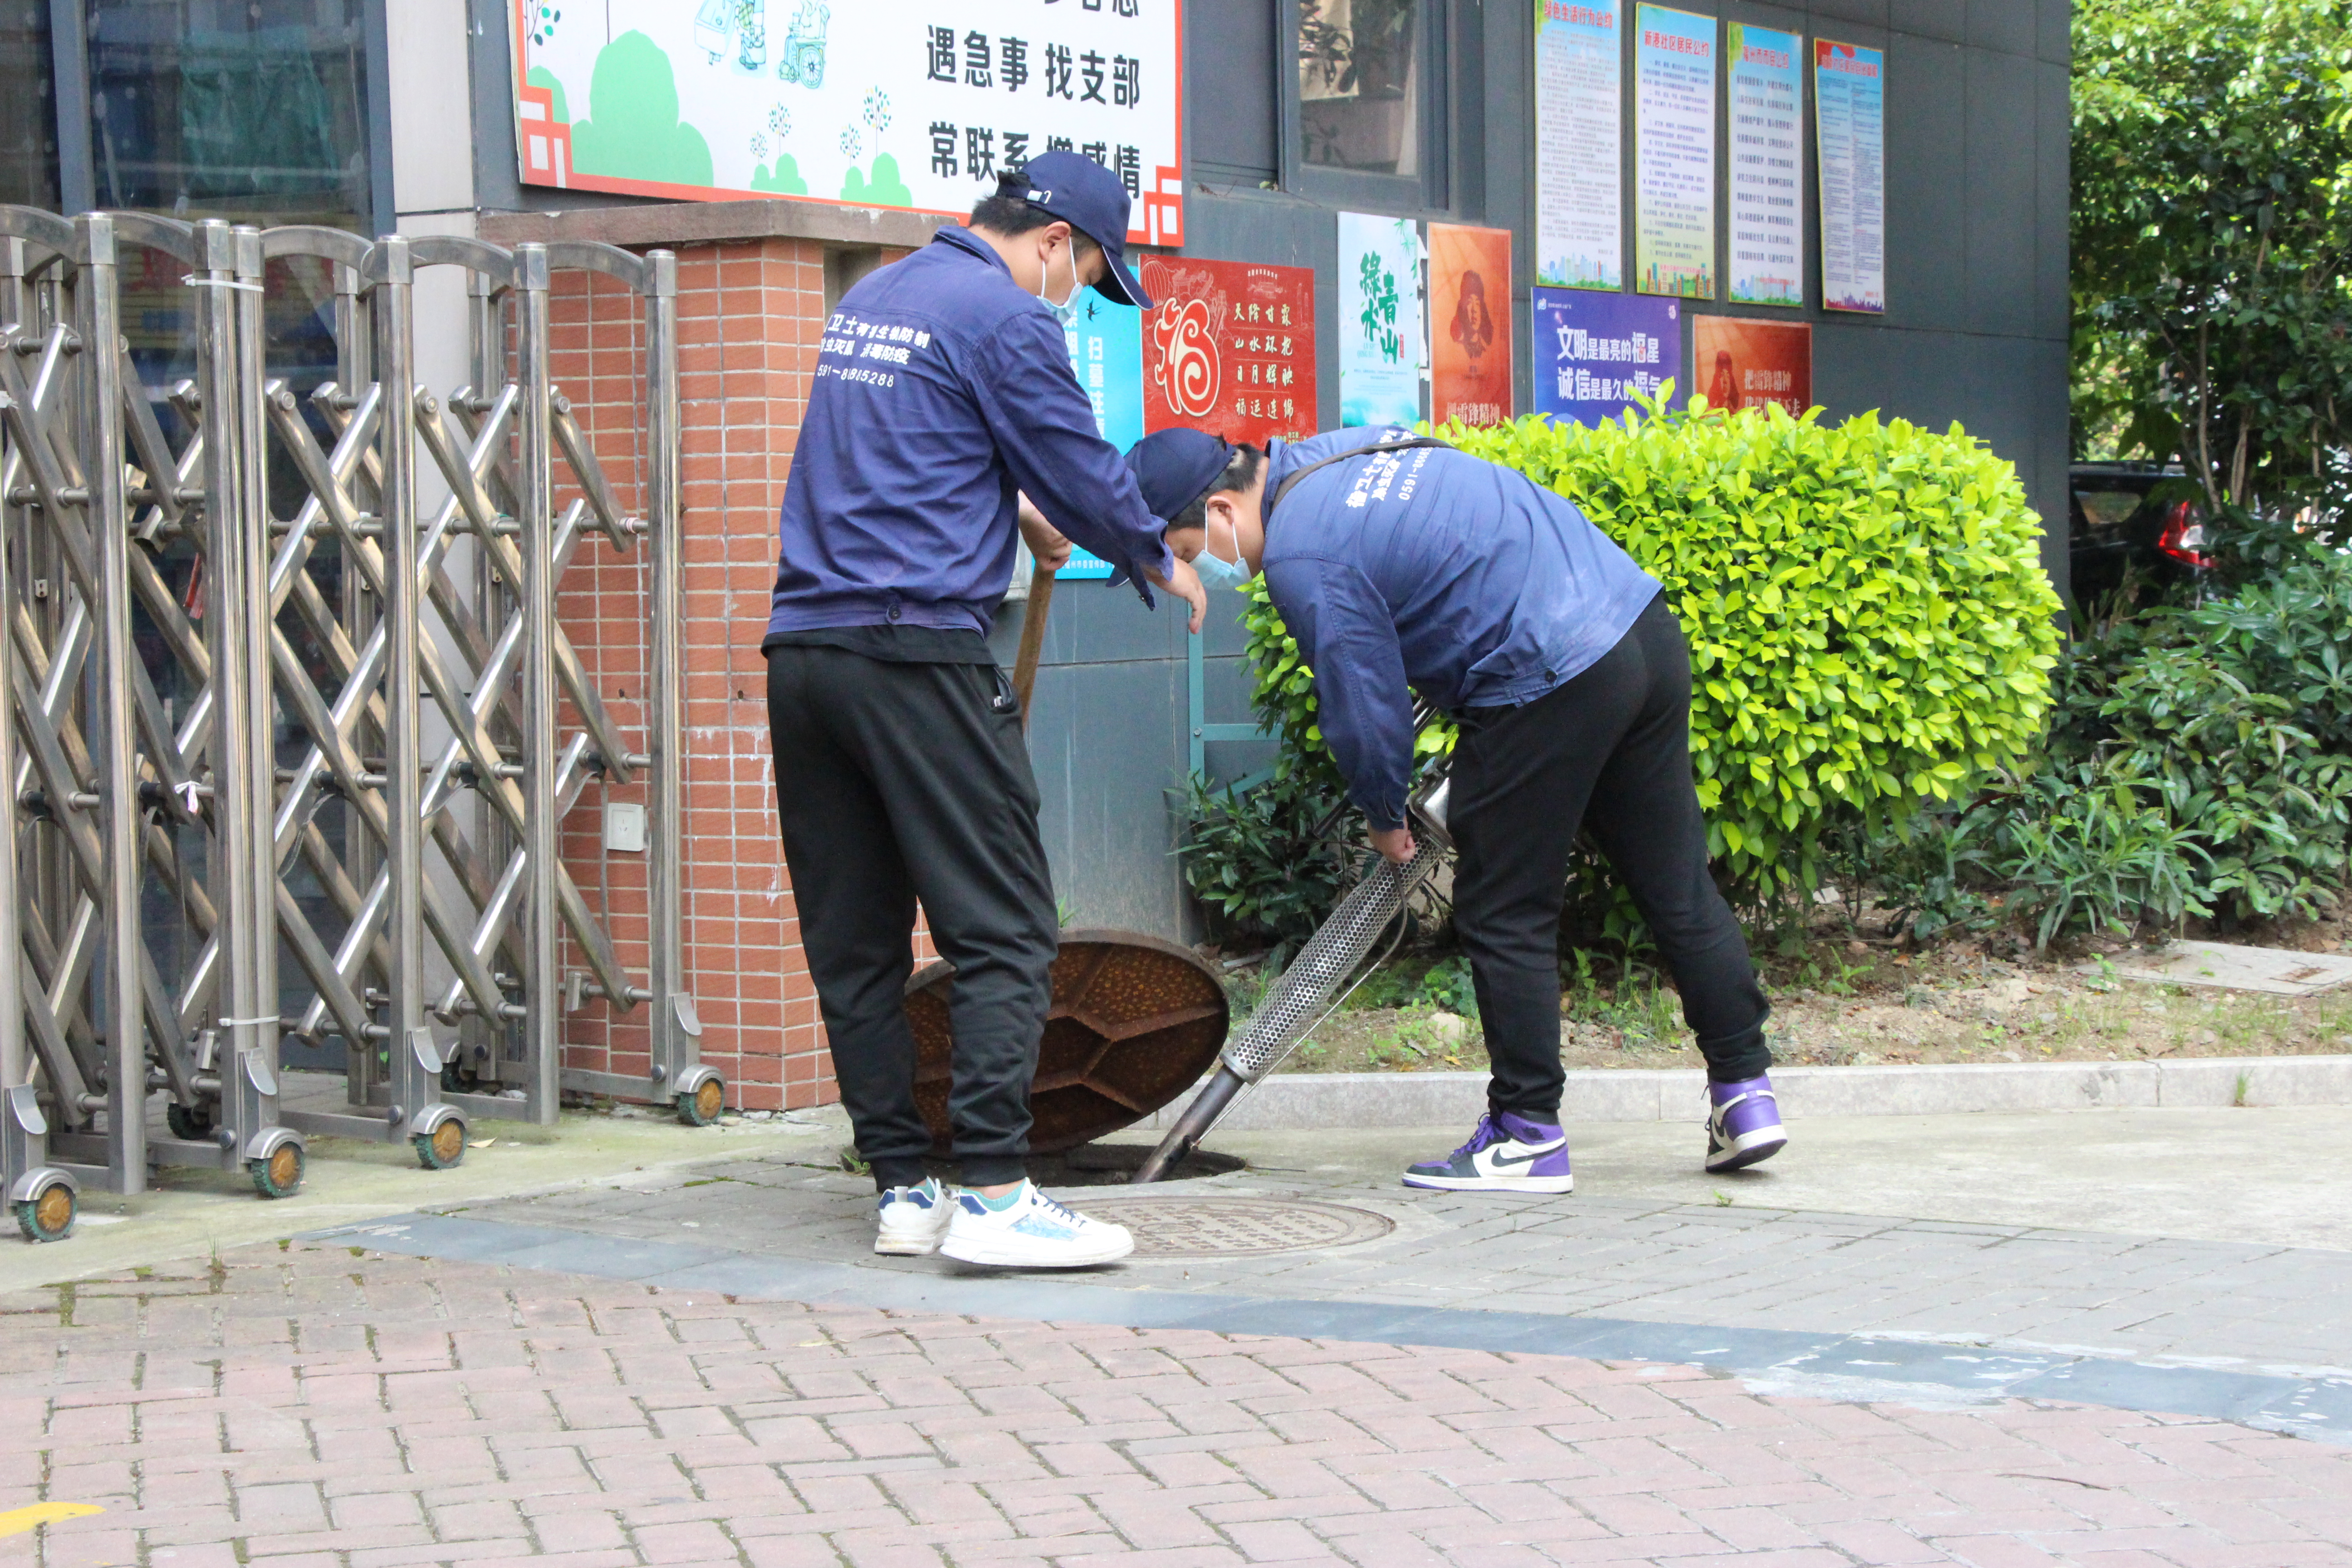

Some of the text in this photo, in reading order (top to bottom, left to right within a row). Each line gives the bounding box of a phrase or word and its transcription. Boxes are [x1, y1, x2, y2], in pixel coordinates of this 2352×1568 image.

[1644, 30, 1710, 58] 新港社区居民公约
[926, 24, 1140, 109] 遇急事 找支部
[1234, 302, 1292, 326] 天降甘霖
[1235, 335, 1293, 356] 山水环抱
[1557, 324, 1660, 363] 文明是最亮的福星
[1237, 364, 1293, 390] 日月辉映
[1235, 398, 1294, 423] 福运连绵
